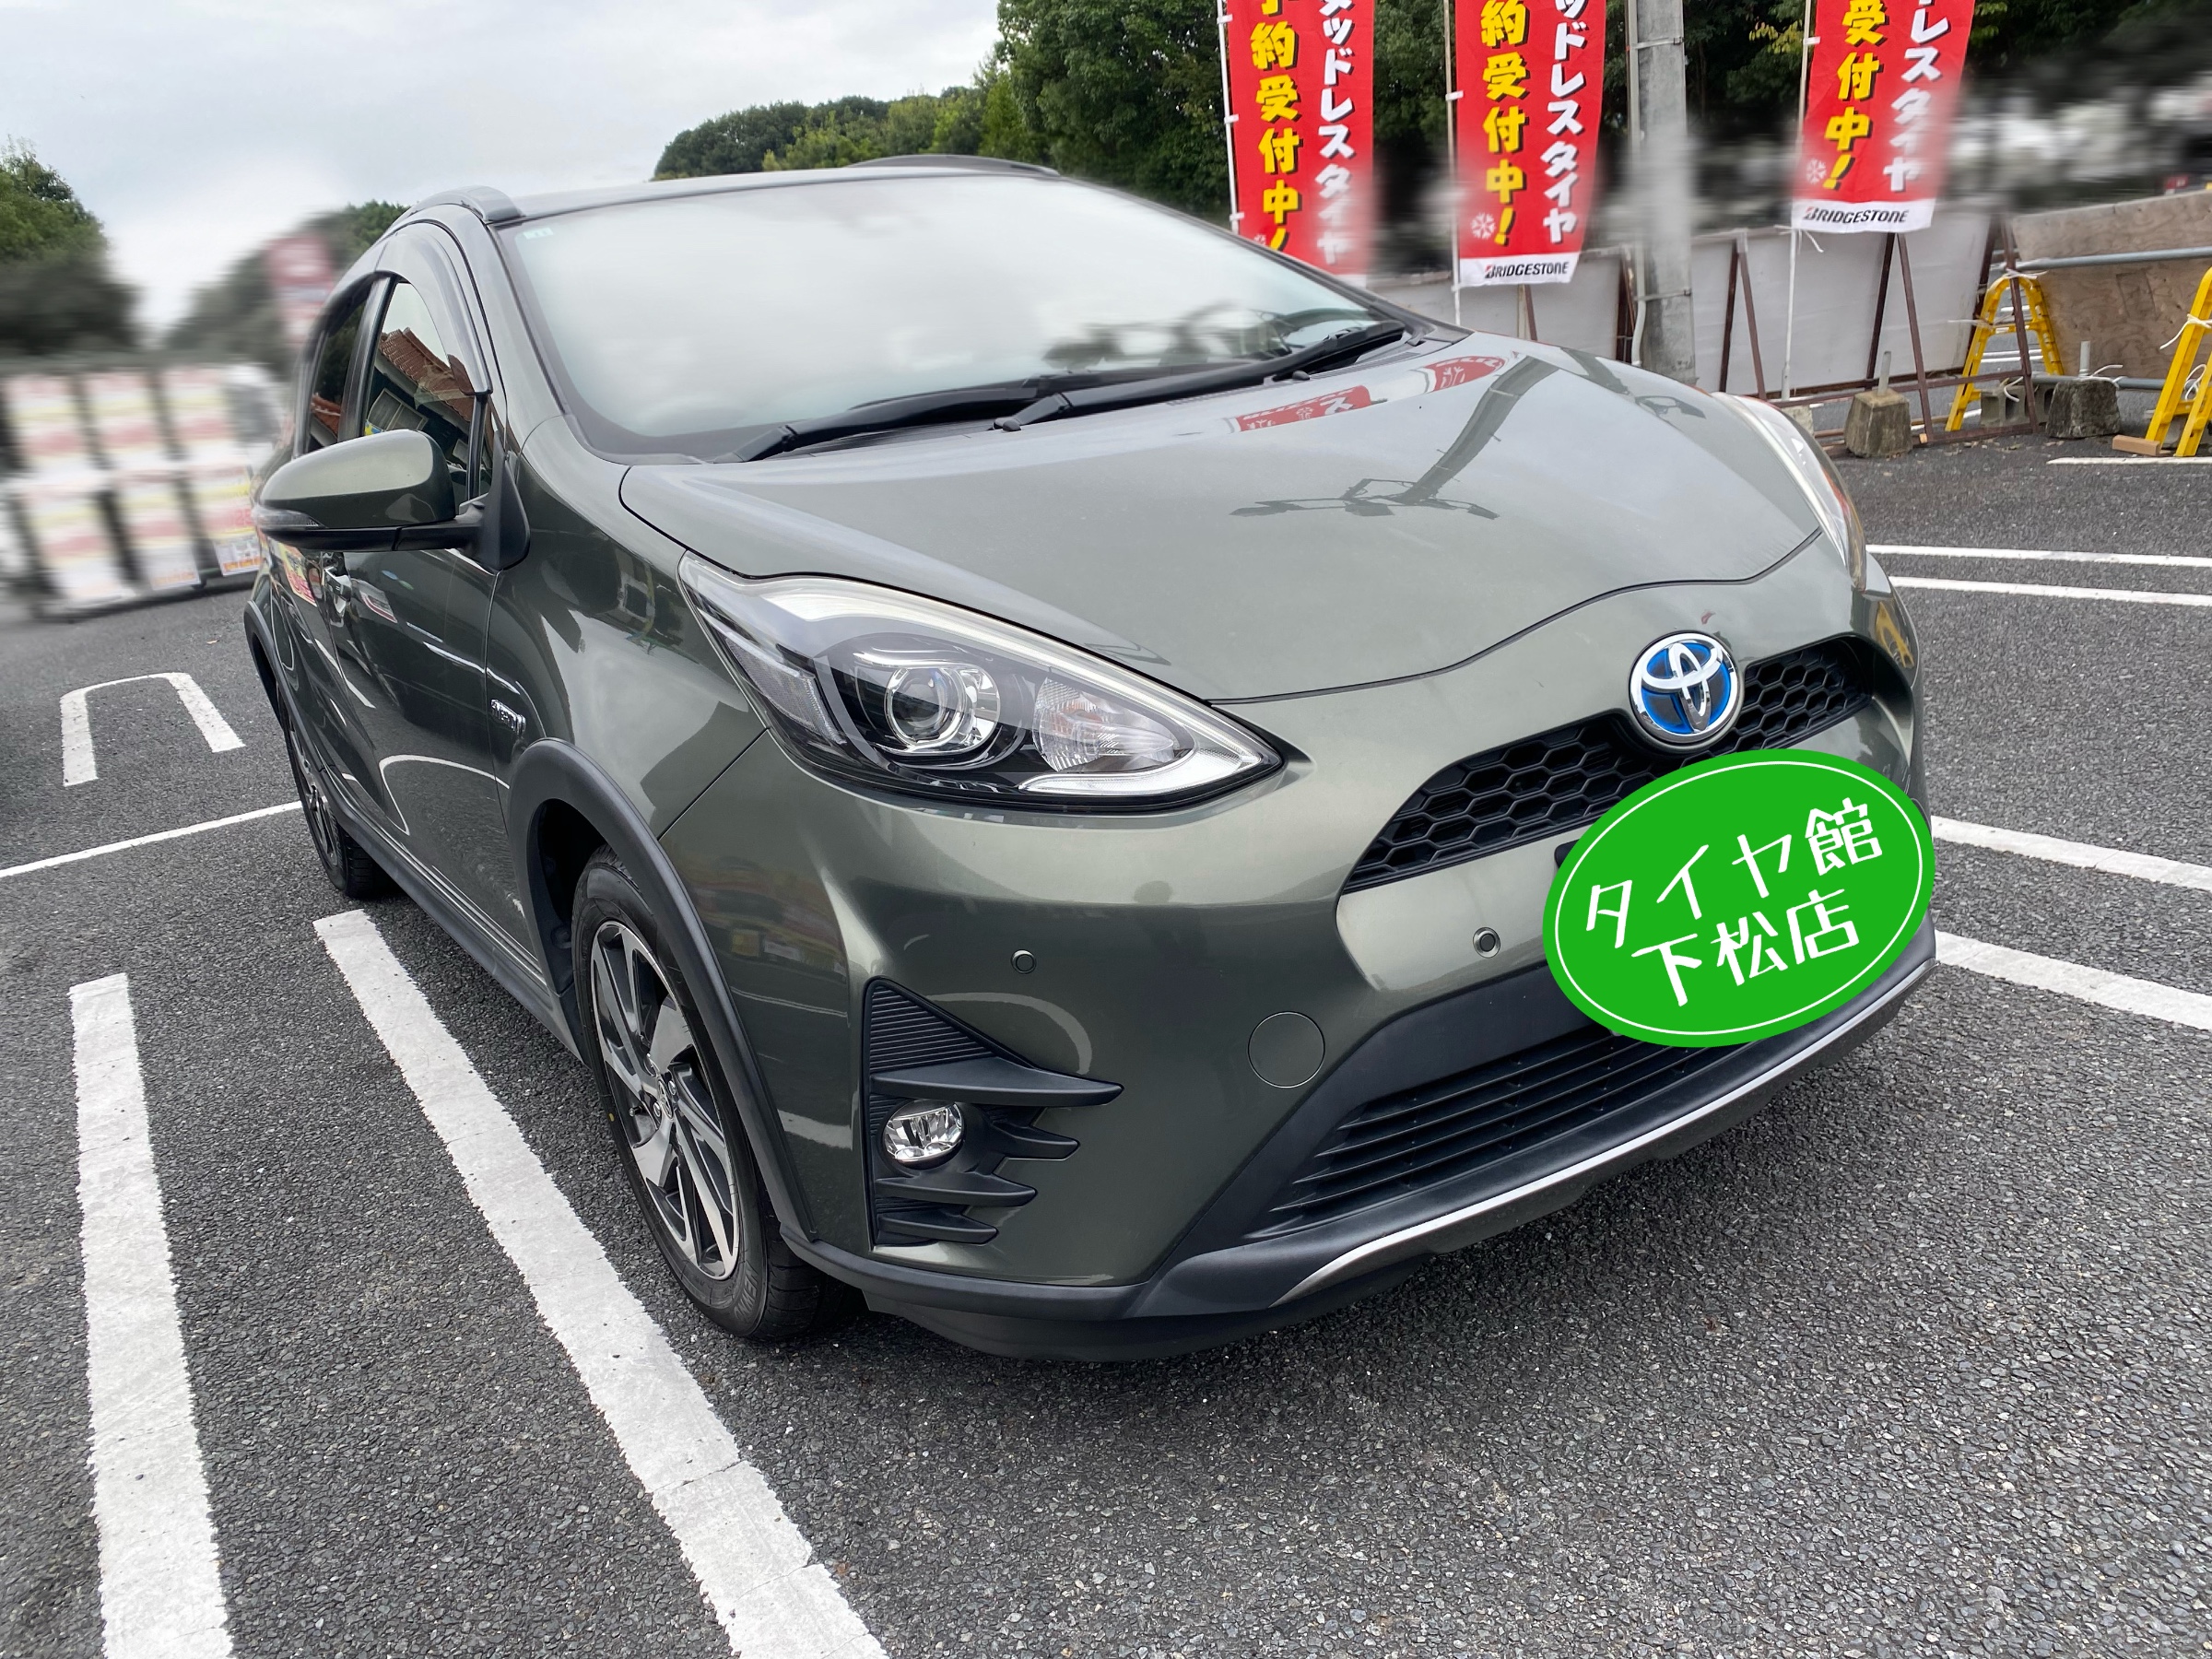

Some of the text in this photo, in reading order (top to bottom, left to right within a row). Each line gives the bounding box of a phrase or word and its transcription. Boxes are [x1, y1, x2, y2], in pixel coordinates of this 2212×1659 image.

[1250, 0, 1301, 251] 約受付中!
[1803, 206, 1909, 224] BRIDGESTONE
[1485, 261, 1569, 279] BRIDGESTONE
